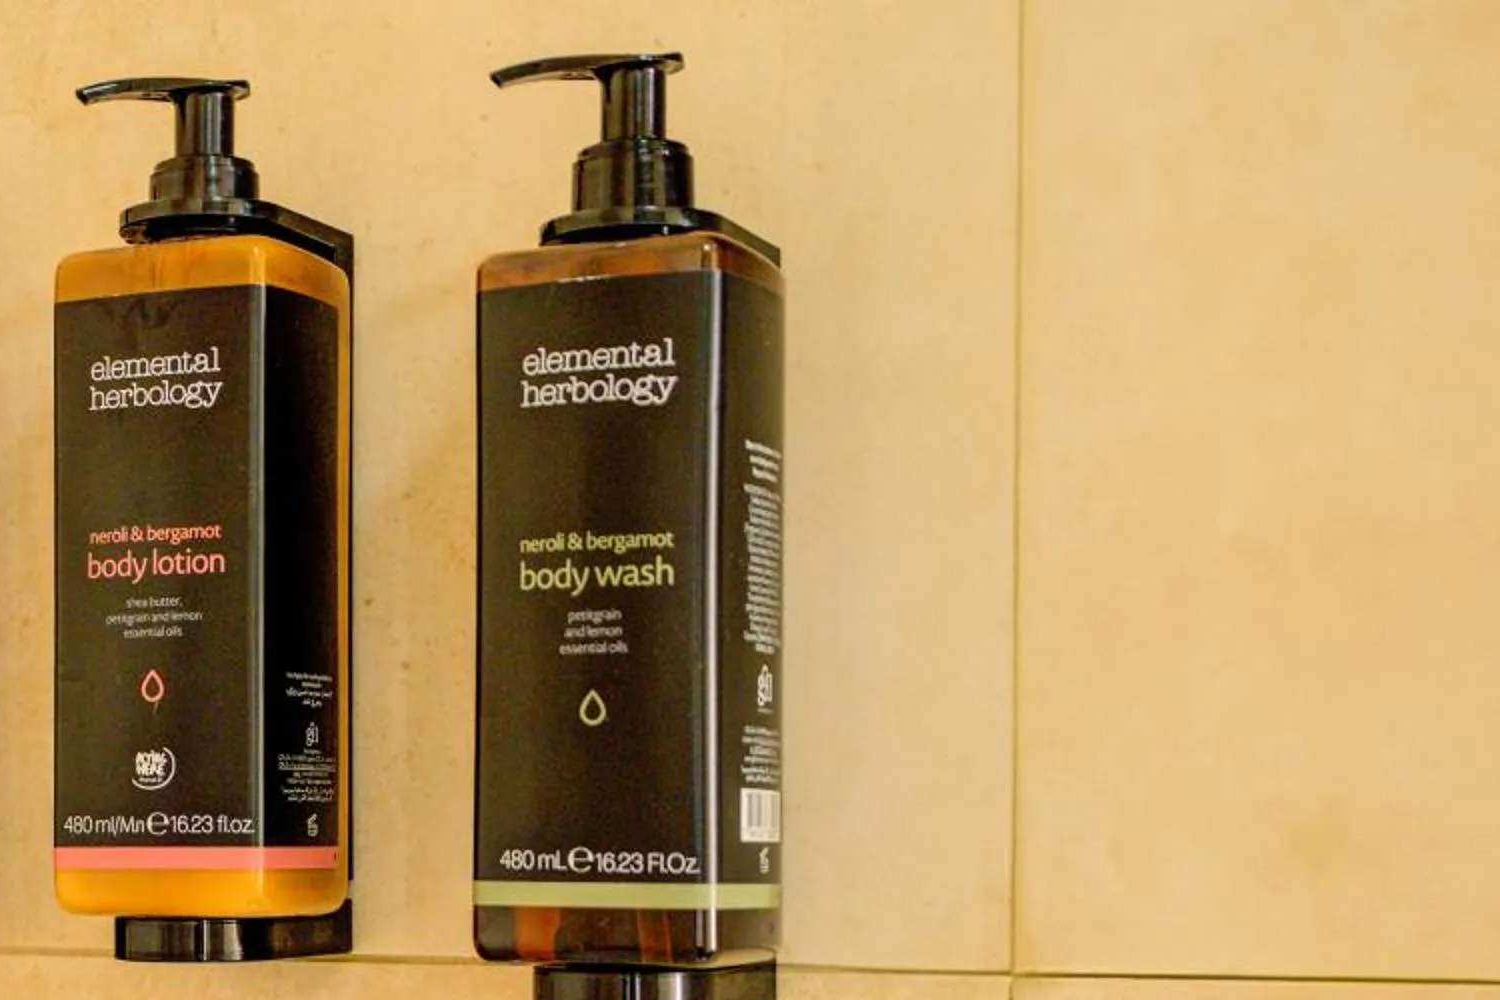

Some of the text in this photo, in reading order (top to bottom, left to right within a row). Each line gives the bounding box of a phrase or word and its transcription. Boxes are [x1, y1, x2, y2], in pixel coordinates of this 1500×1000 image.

[90, 346, 221, 382] elemental
[522, 337, 675, 376] elemental
[89, 379, 223, 411] herbology
[520, 373, 679, 409] herbology
[90, 524, 222, 545] neroli & bergamot
[519, 530, 675, 555] neroli & bergamot
[87, 547, 225, 585] body lotion
[519, 554, 675, 597] body wash
[564, 625, 623, 638] and lemon
[63, 815, 93, 834] 480
[169, 815, 214, 834] 16.23
[499, 849, 535, 870] 480
[537, 849, 567, 871] mL
[595, 851, 644, 873] 16.23
